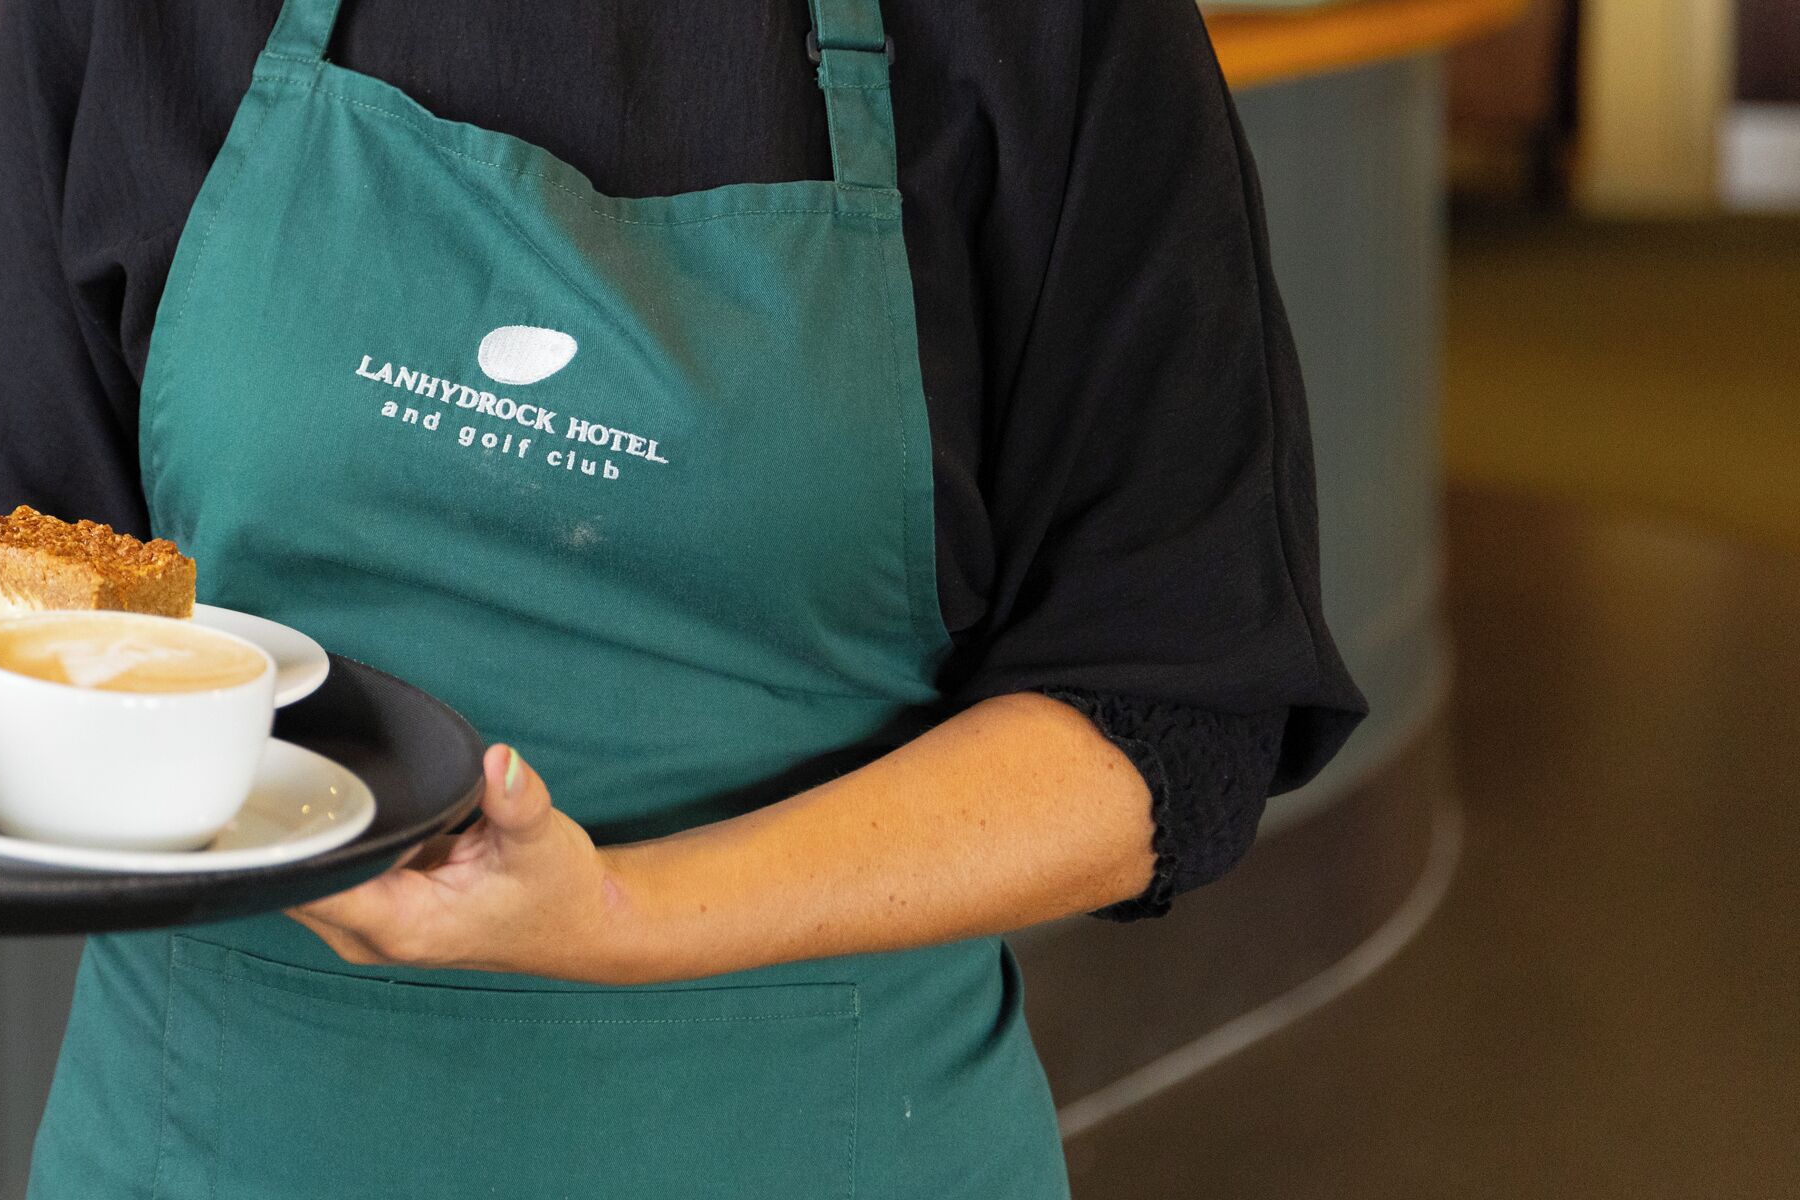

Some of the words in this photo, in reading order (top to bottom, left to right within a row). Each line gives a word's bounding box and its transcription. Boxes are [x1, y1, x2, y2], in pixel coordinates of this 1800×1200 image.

[356, 355, 555, 433] LANHYDROCK
[566, 417, 669, 463] HOTEL
[381, 400, 441, 431] and
[458, 425, 531, 459] golf
[547, 448, 620, 480] club
